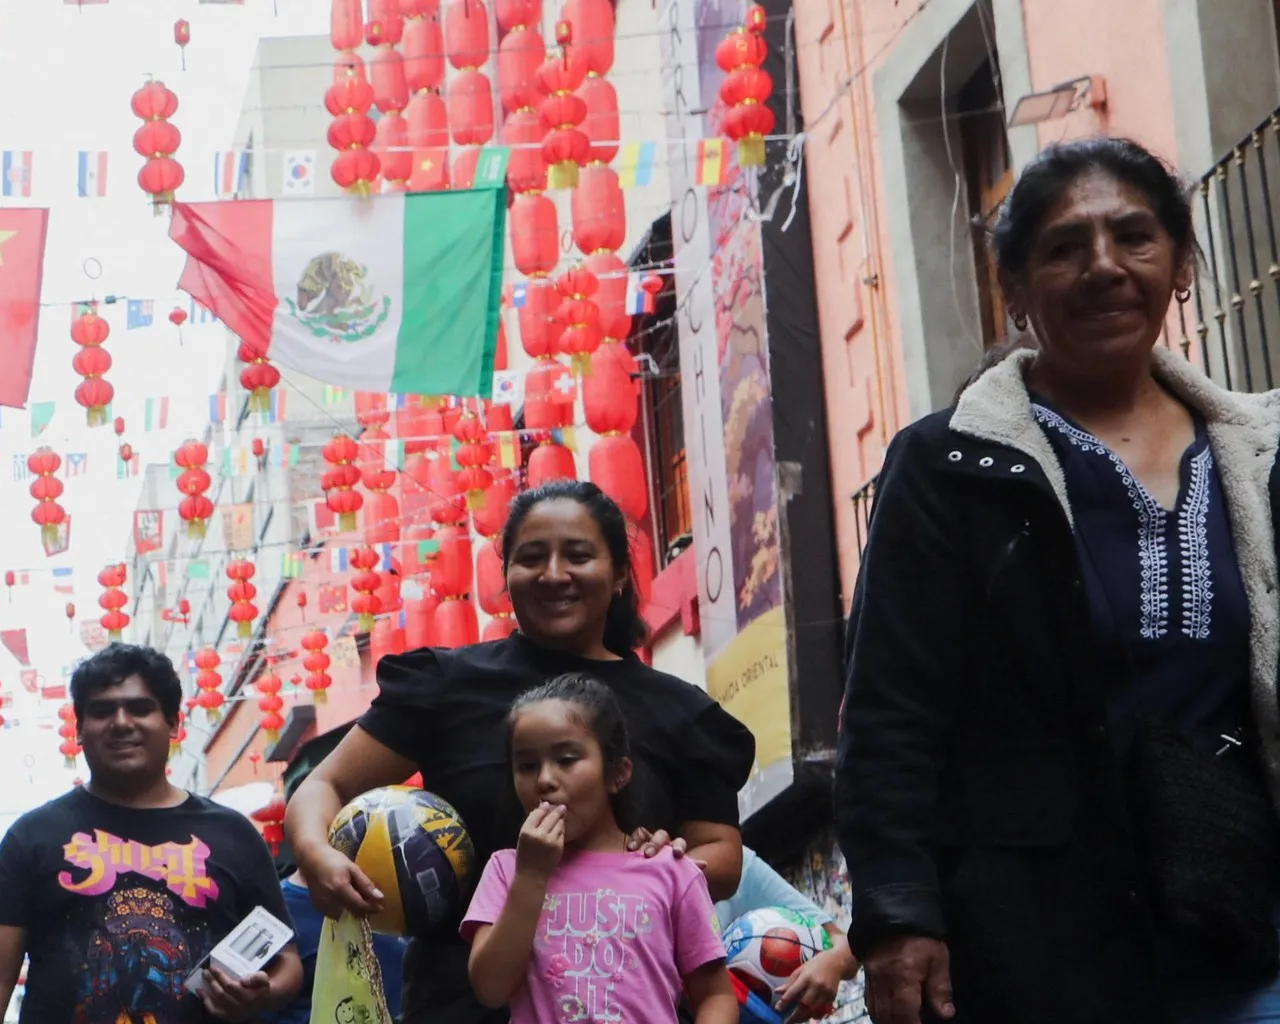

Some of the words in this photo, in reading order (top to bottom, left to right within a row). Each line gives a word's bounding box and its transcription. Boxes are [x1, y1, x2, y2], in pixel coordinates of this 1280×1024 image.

[686, 282, 724, 604] CHINO
[547, 892, 645, 938] JUST
[563, 934, 625, 978] DO
